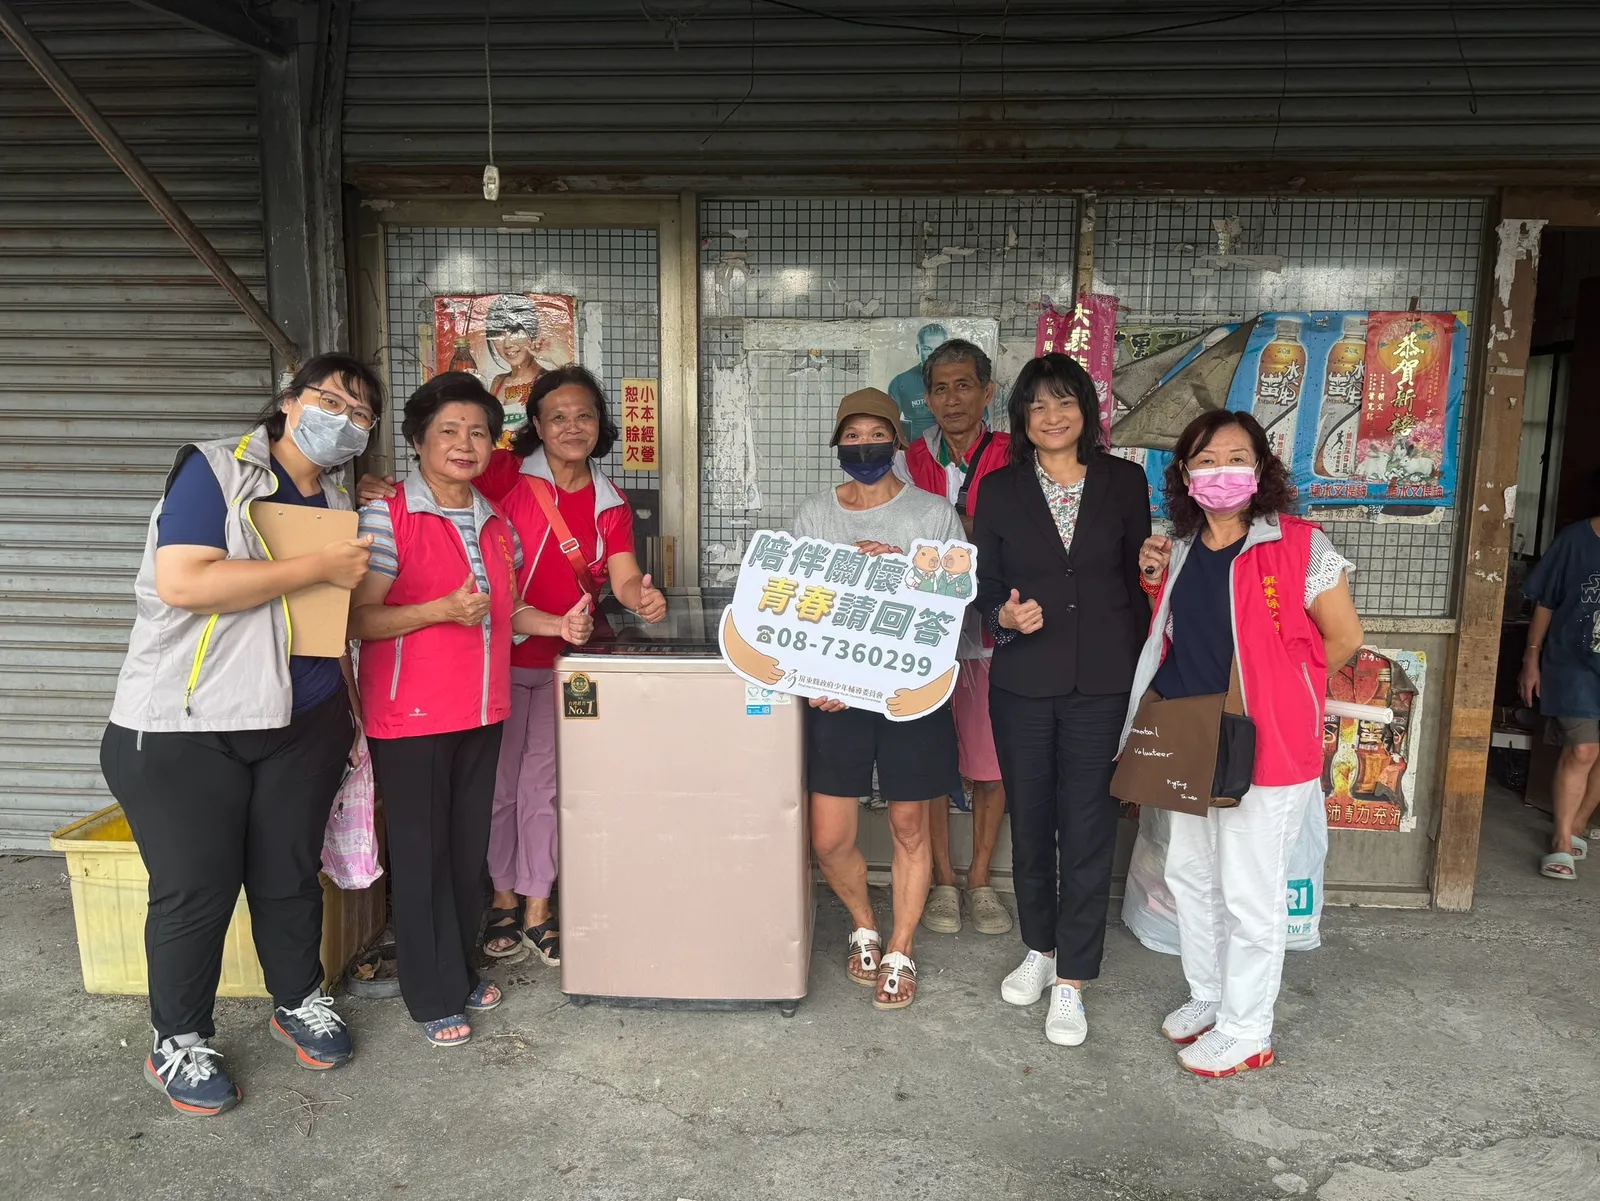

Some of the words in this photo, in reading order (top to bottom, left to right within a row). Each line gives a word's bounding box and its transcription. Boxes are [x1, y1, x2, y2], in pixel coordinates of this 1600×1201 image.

[1387, 331, 1425, 436] 恭賀新禧
[624, 385, 640, 463] 恕不賒欠
[641, 385, 655, 463] 小本經營
[748, 533, 909, 595] 陪伴關懷
[757, 576, 956, 648] 青春請回答
[776, 626, 933, 677] 08-7360299
